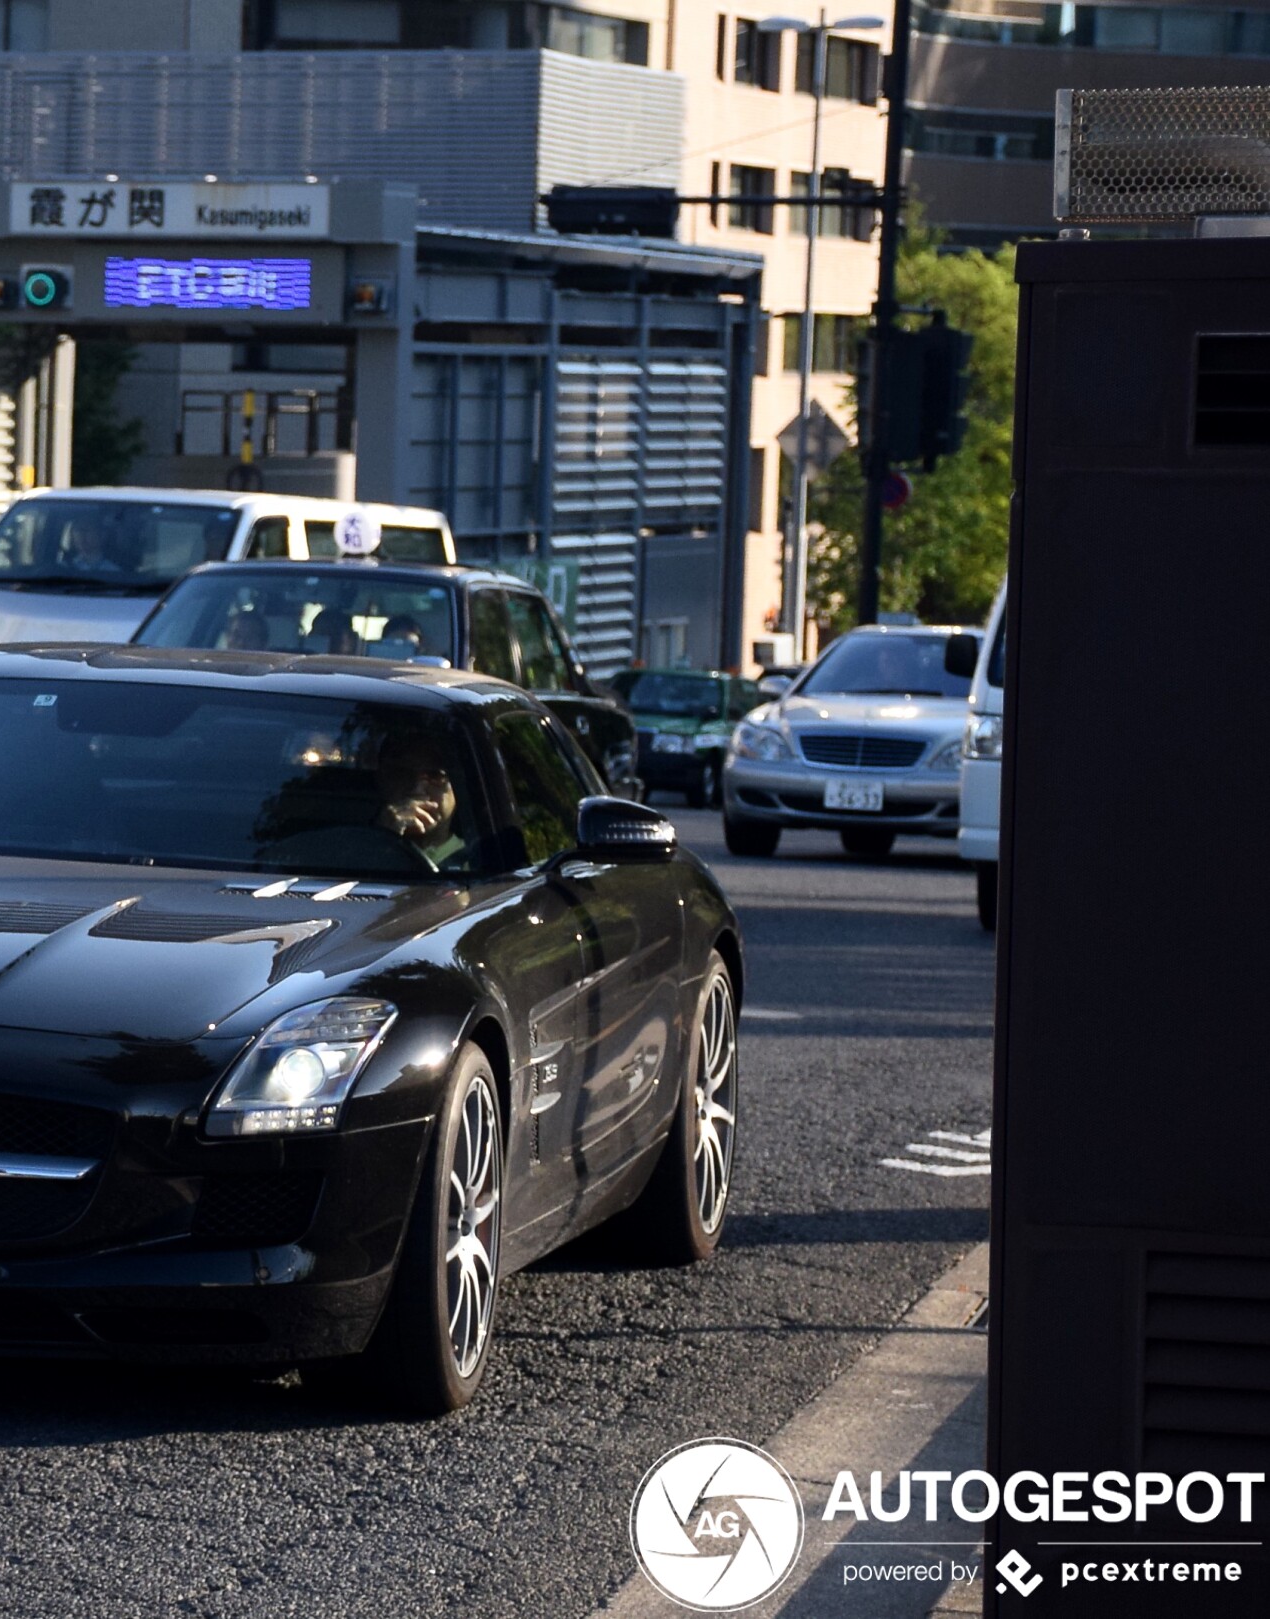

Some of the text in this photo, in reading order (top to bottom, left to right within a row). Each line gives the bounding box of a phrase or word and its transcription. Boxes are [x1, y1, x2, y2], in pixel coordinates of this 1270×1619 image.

[29, 187, 165, 228] 霞が関
[196, 204, 311, 231] Kasumigaseki
